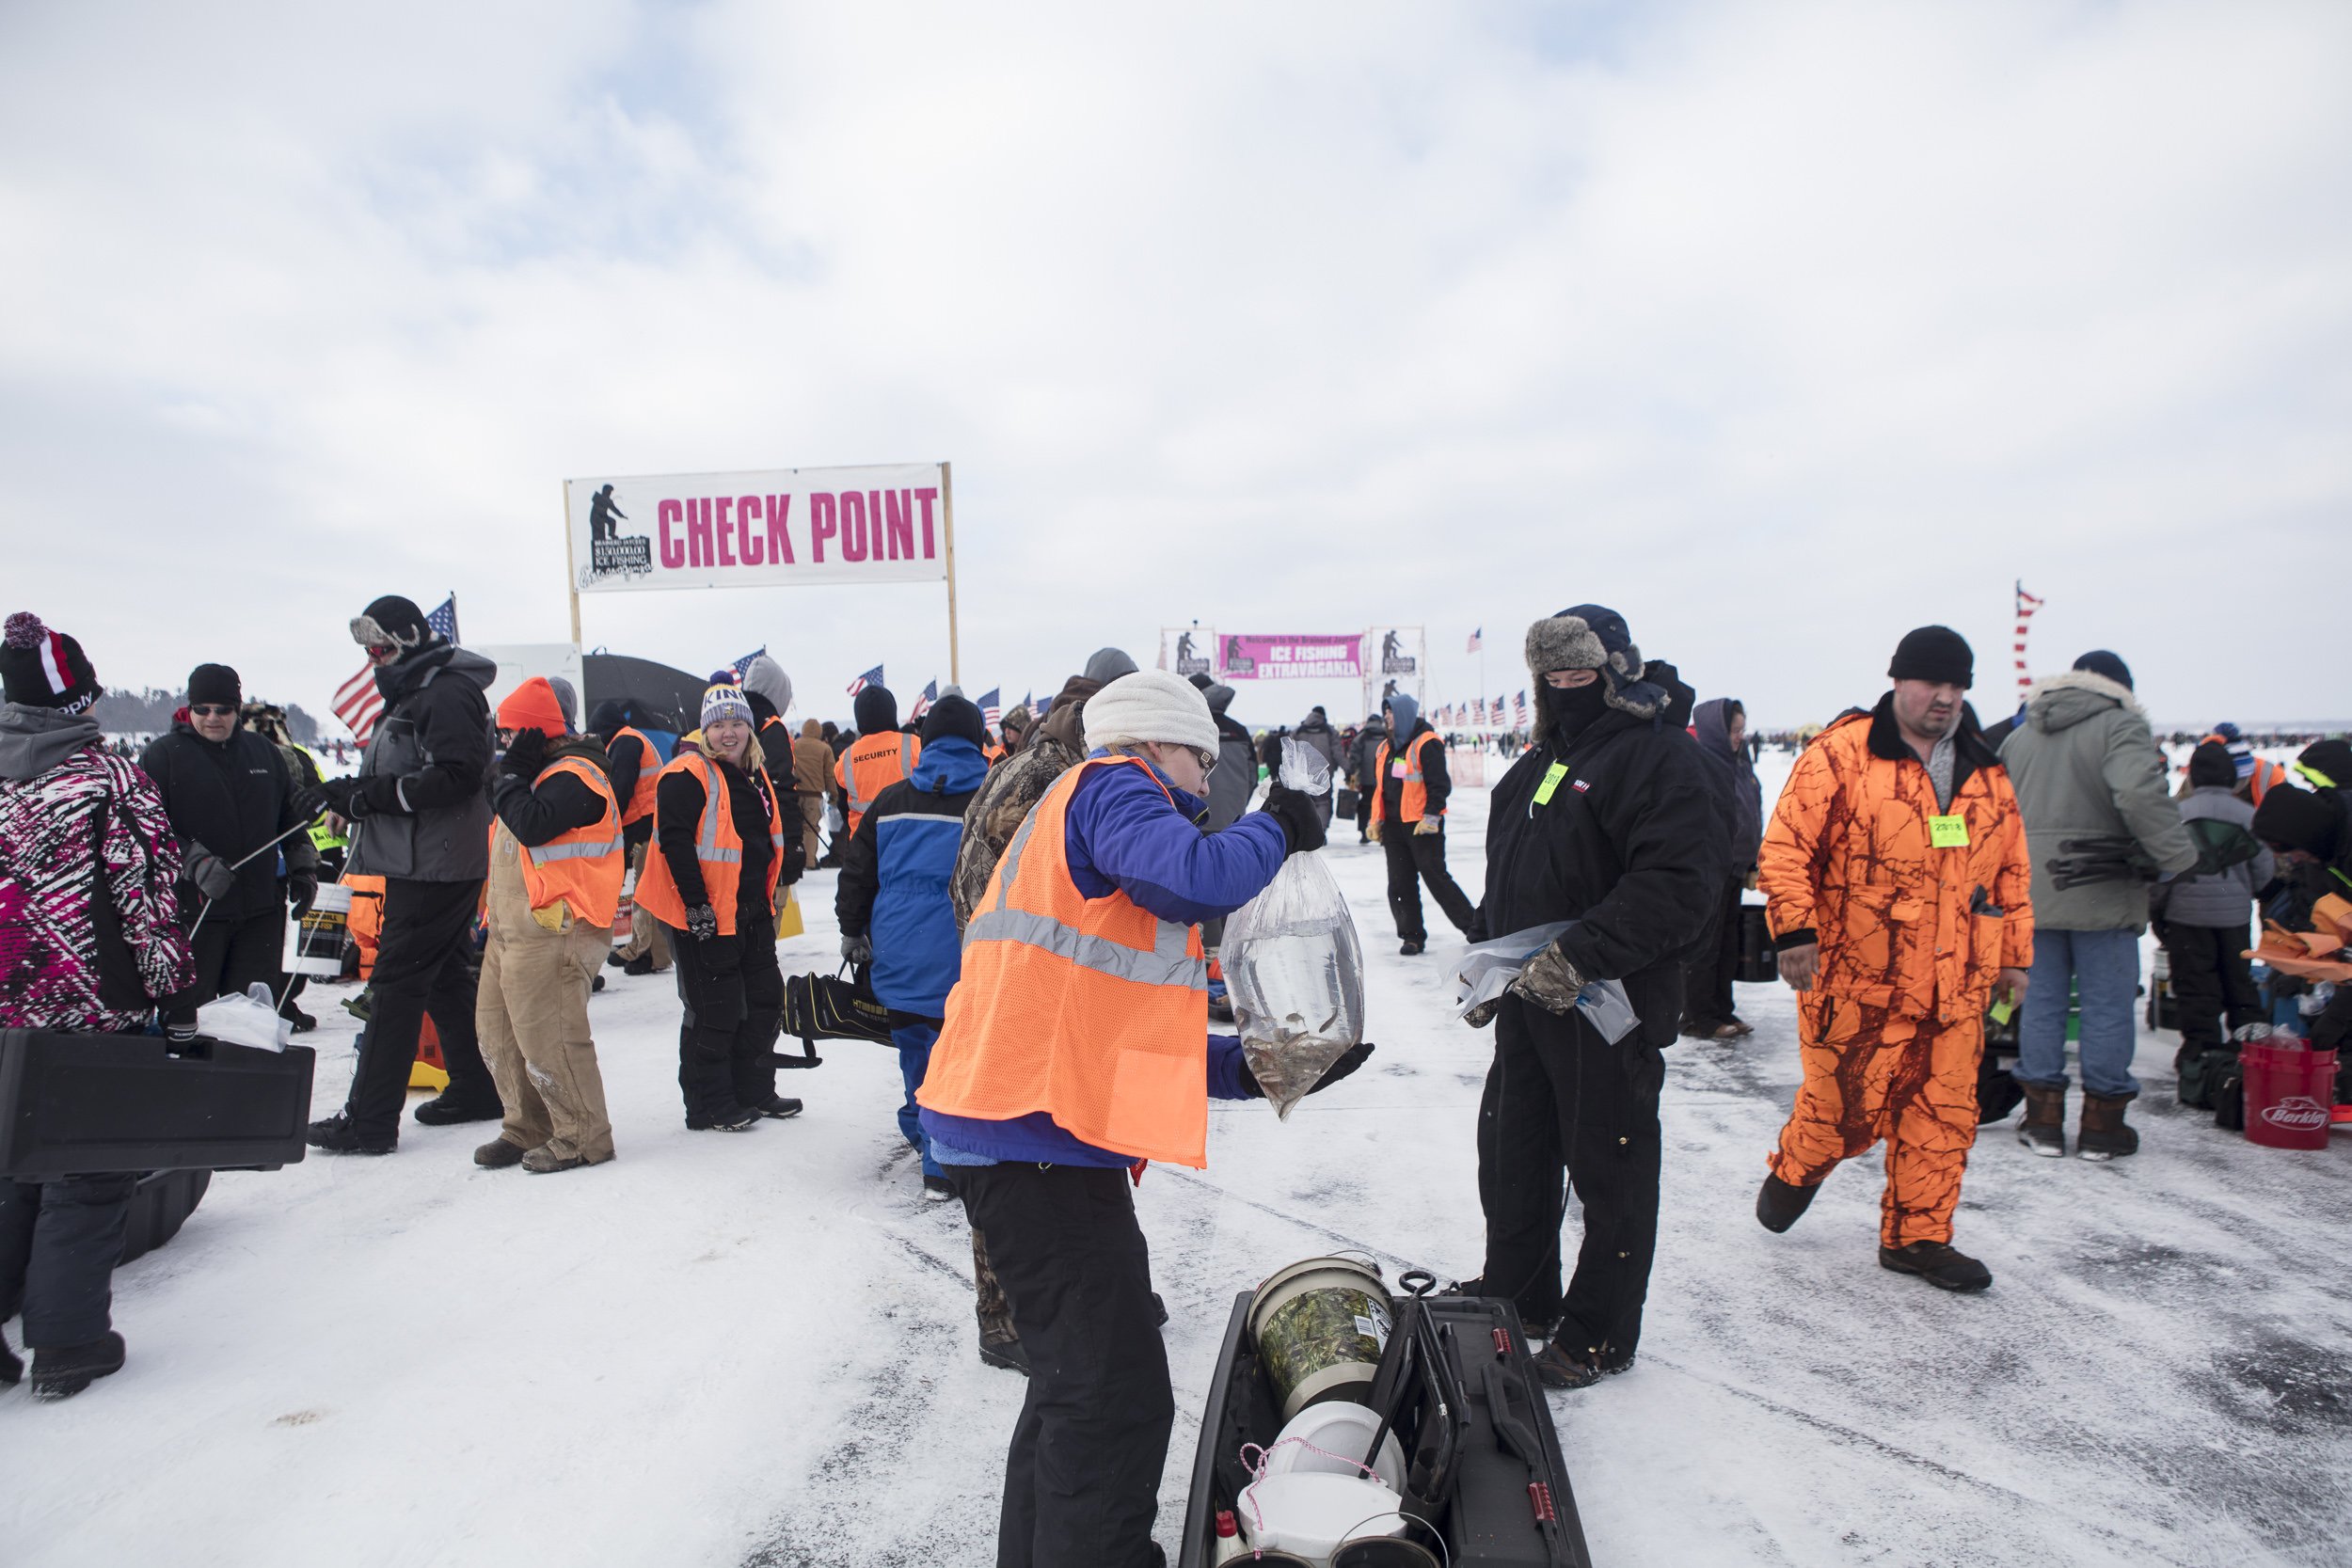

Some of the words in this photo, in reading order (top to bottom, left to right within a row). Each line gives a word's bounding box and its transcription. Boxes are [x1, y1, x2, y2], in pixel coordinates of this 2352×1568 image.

[658, 495, 795, 568] CHECK
[810, 488, 937, 562] POINT
[612, 555, 646, 565] FISHING
[1270, 646, 1292, 661] ICE
[1295, 644, 1347, 660] FISHING
[1258, 661, 1359, 679] EXTRAVAGANZA
[853, 748, 898, 763] SECURITY
[2270, 1110, 2328, 1128] Berkley
